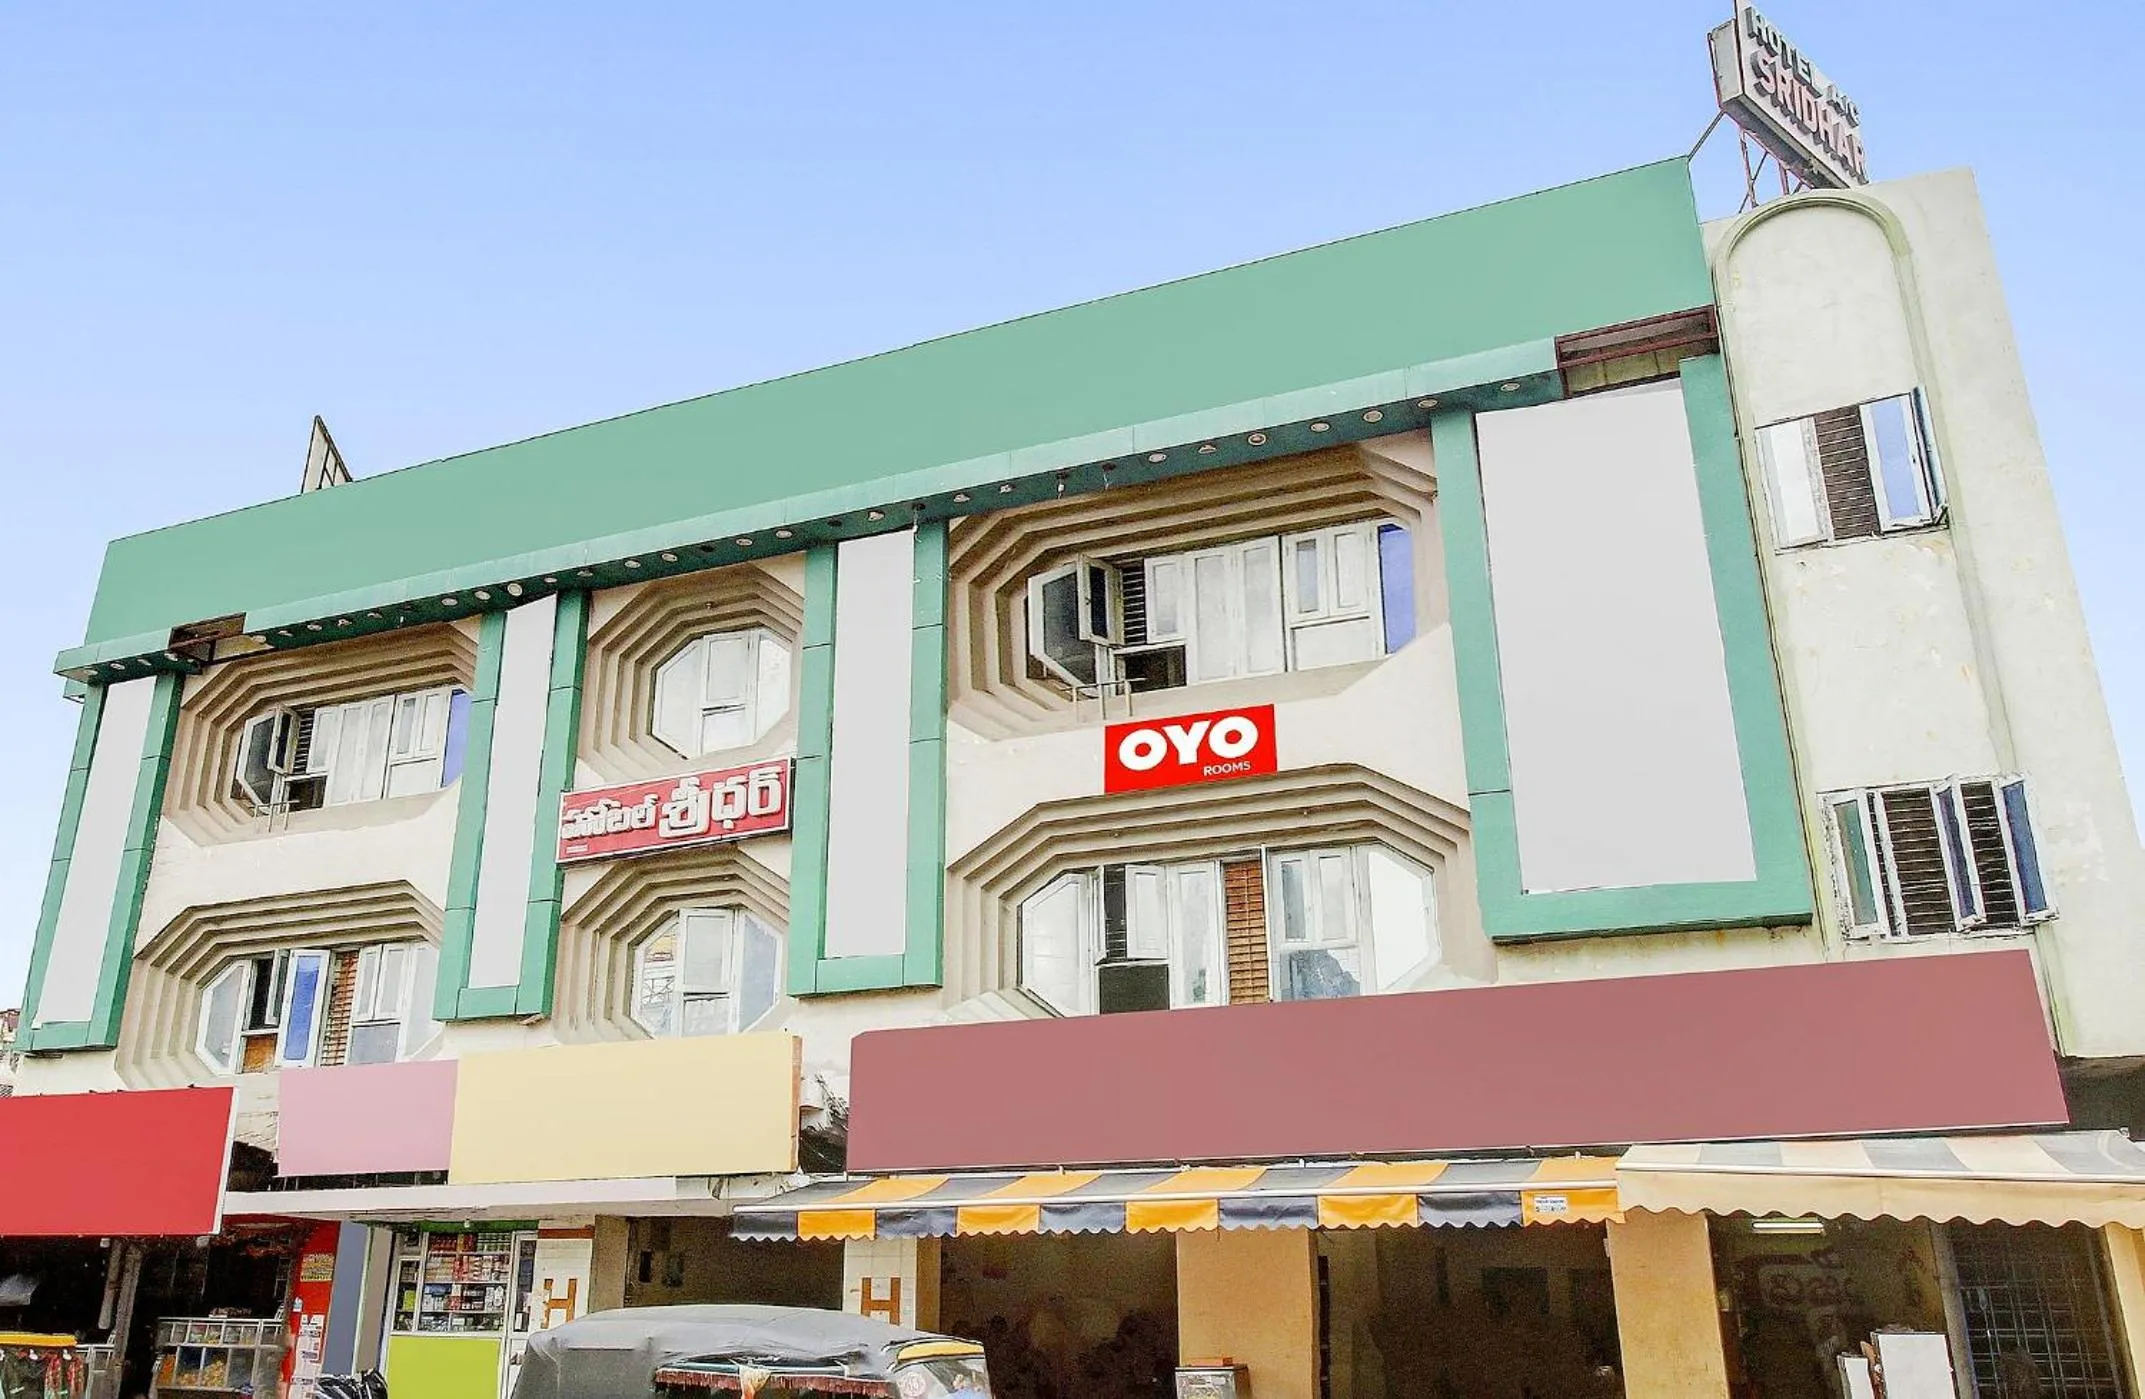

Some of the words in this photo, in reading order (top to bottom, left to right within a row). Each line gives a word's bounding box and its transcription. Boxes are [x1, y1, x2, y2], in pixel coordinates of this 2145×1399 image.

[1745, 7, 1822, 97] HOTEL
[1751, 51, 1869, 185] SRIDHAR
[1119, 716, 1258, 771] OYO
[1203, 761, 1251, 777] ROOMS
